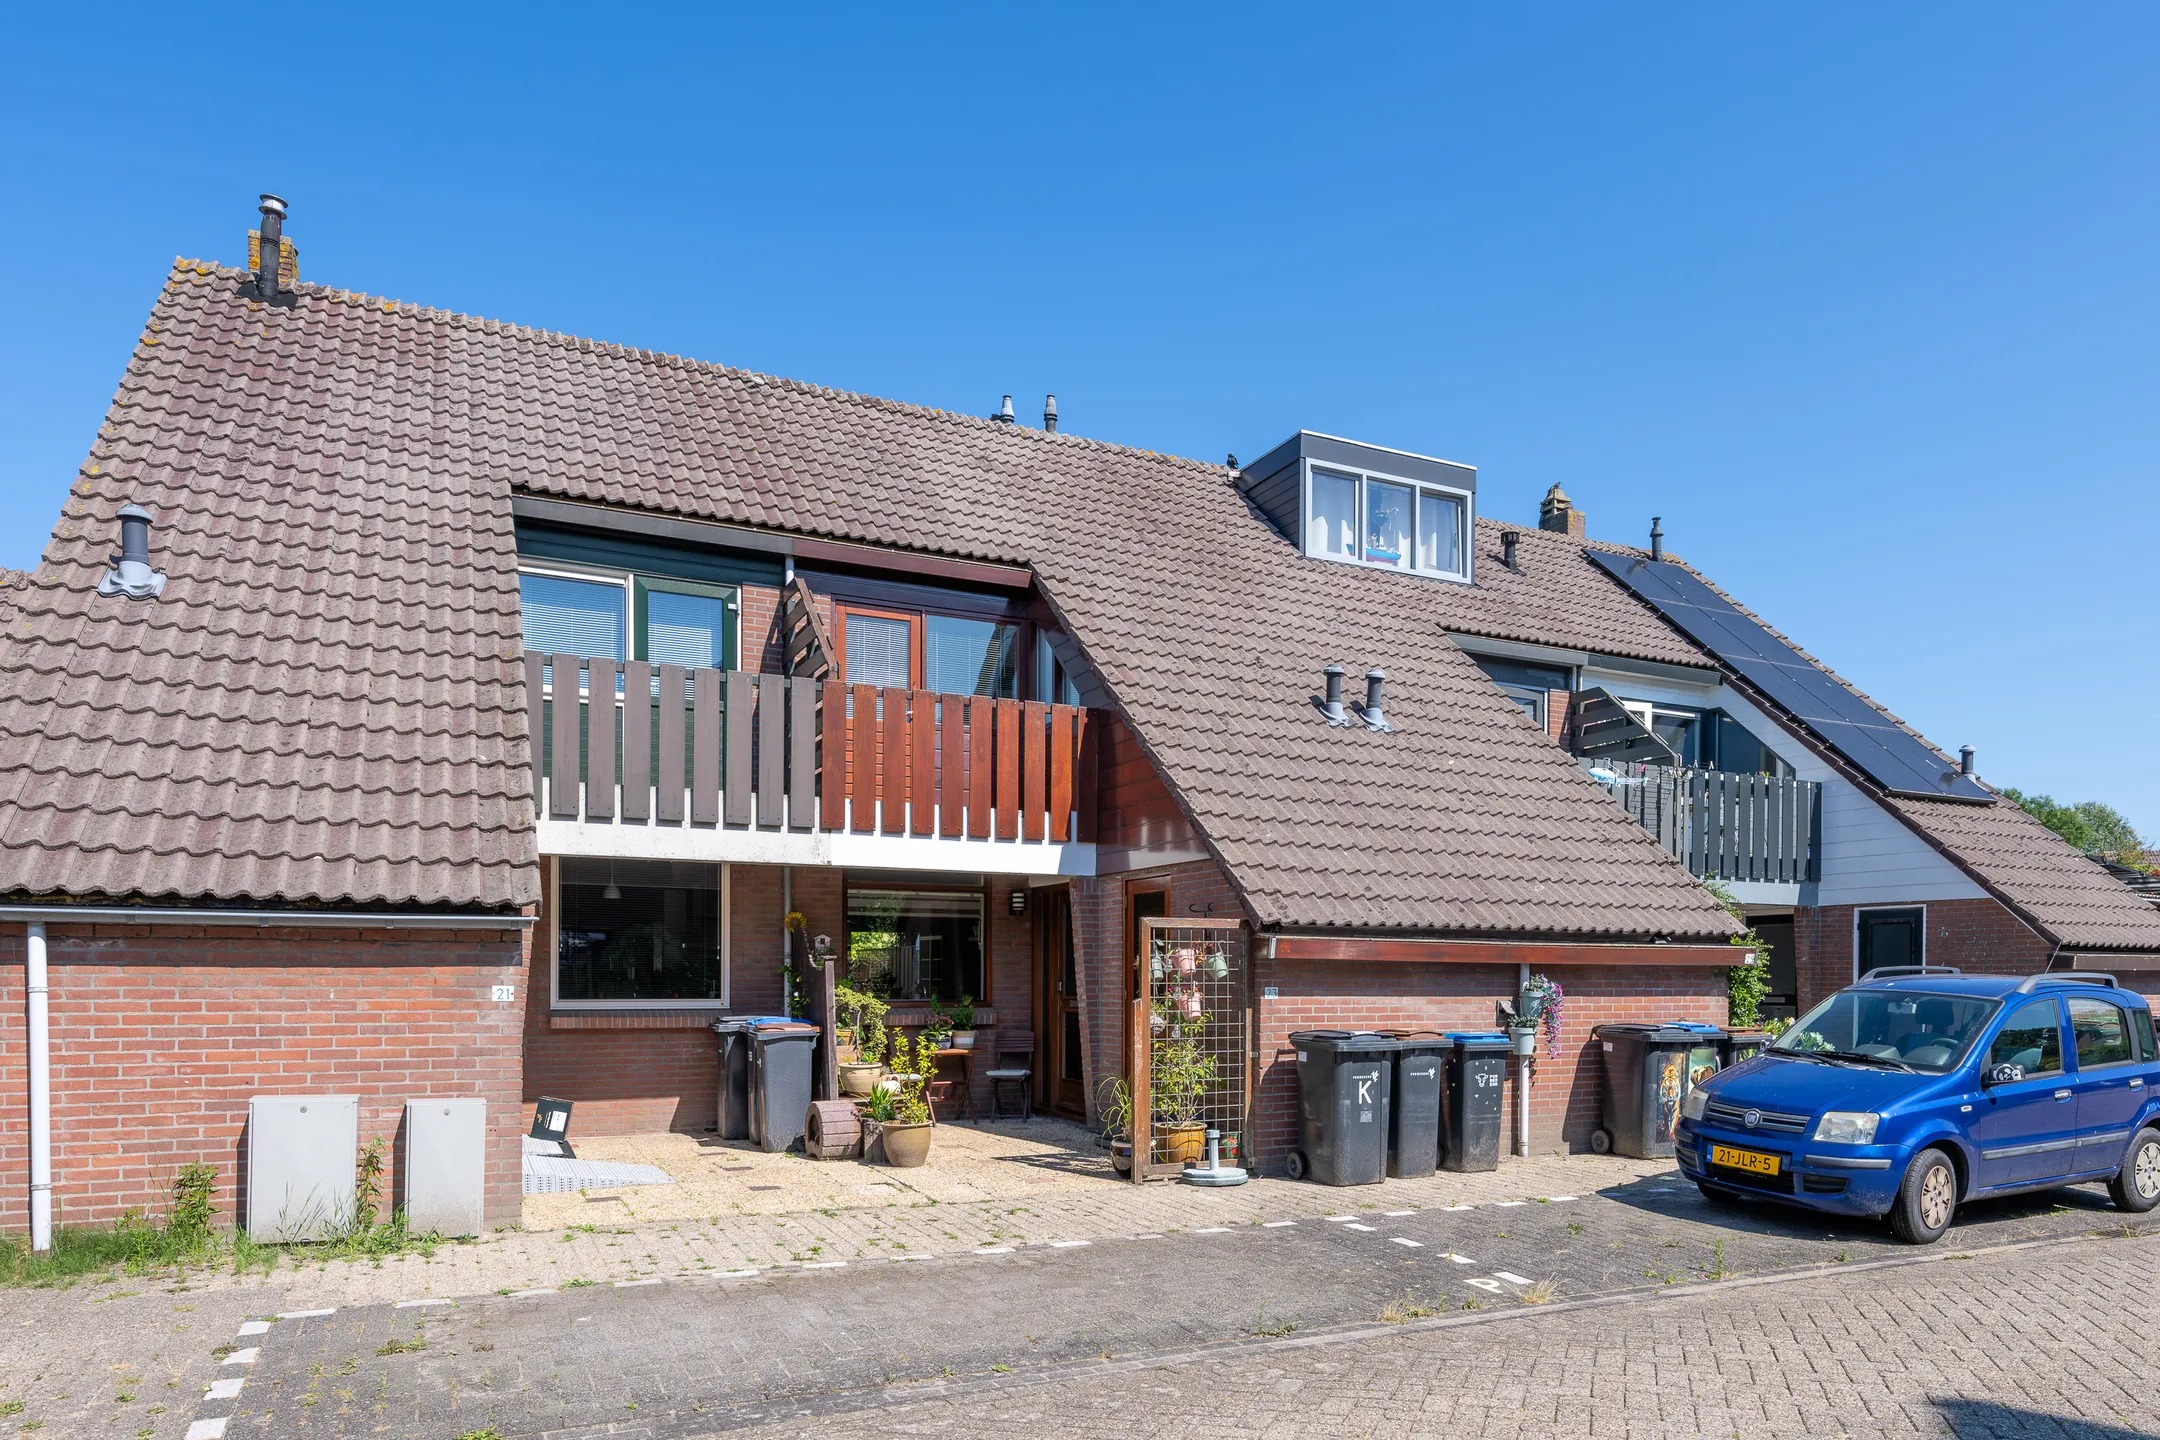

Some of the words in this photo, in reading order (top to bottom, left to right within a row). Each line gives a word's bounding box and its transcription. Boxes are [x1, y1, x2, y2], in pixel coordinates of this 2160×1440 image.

[497, 988, 510, 999] 21
[1358, 1080, 1373, 1104] K
[1718, 1149, 1771, 1171] 21-JLR-5
[1463, 1278, 1504, 1294] P
